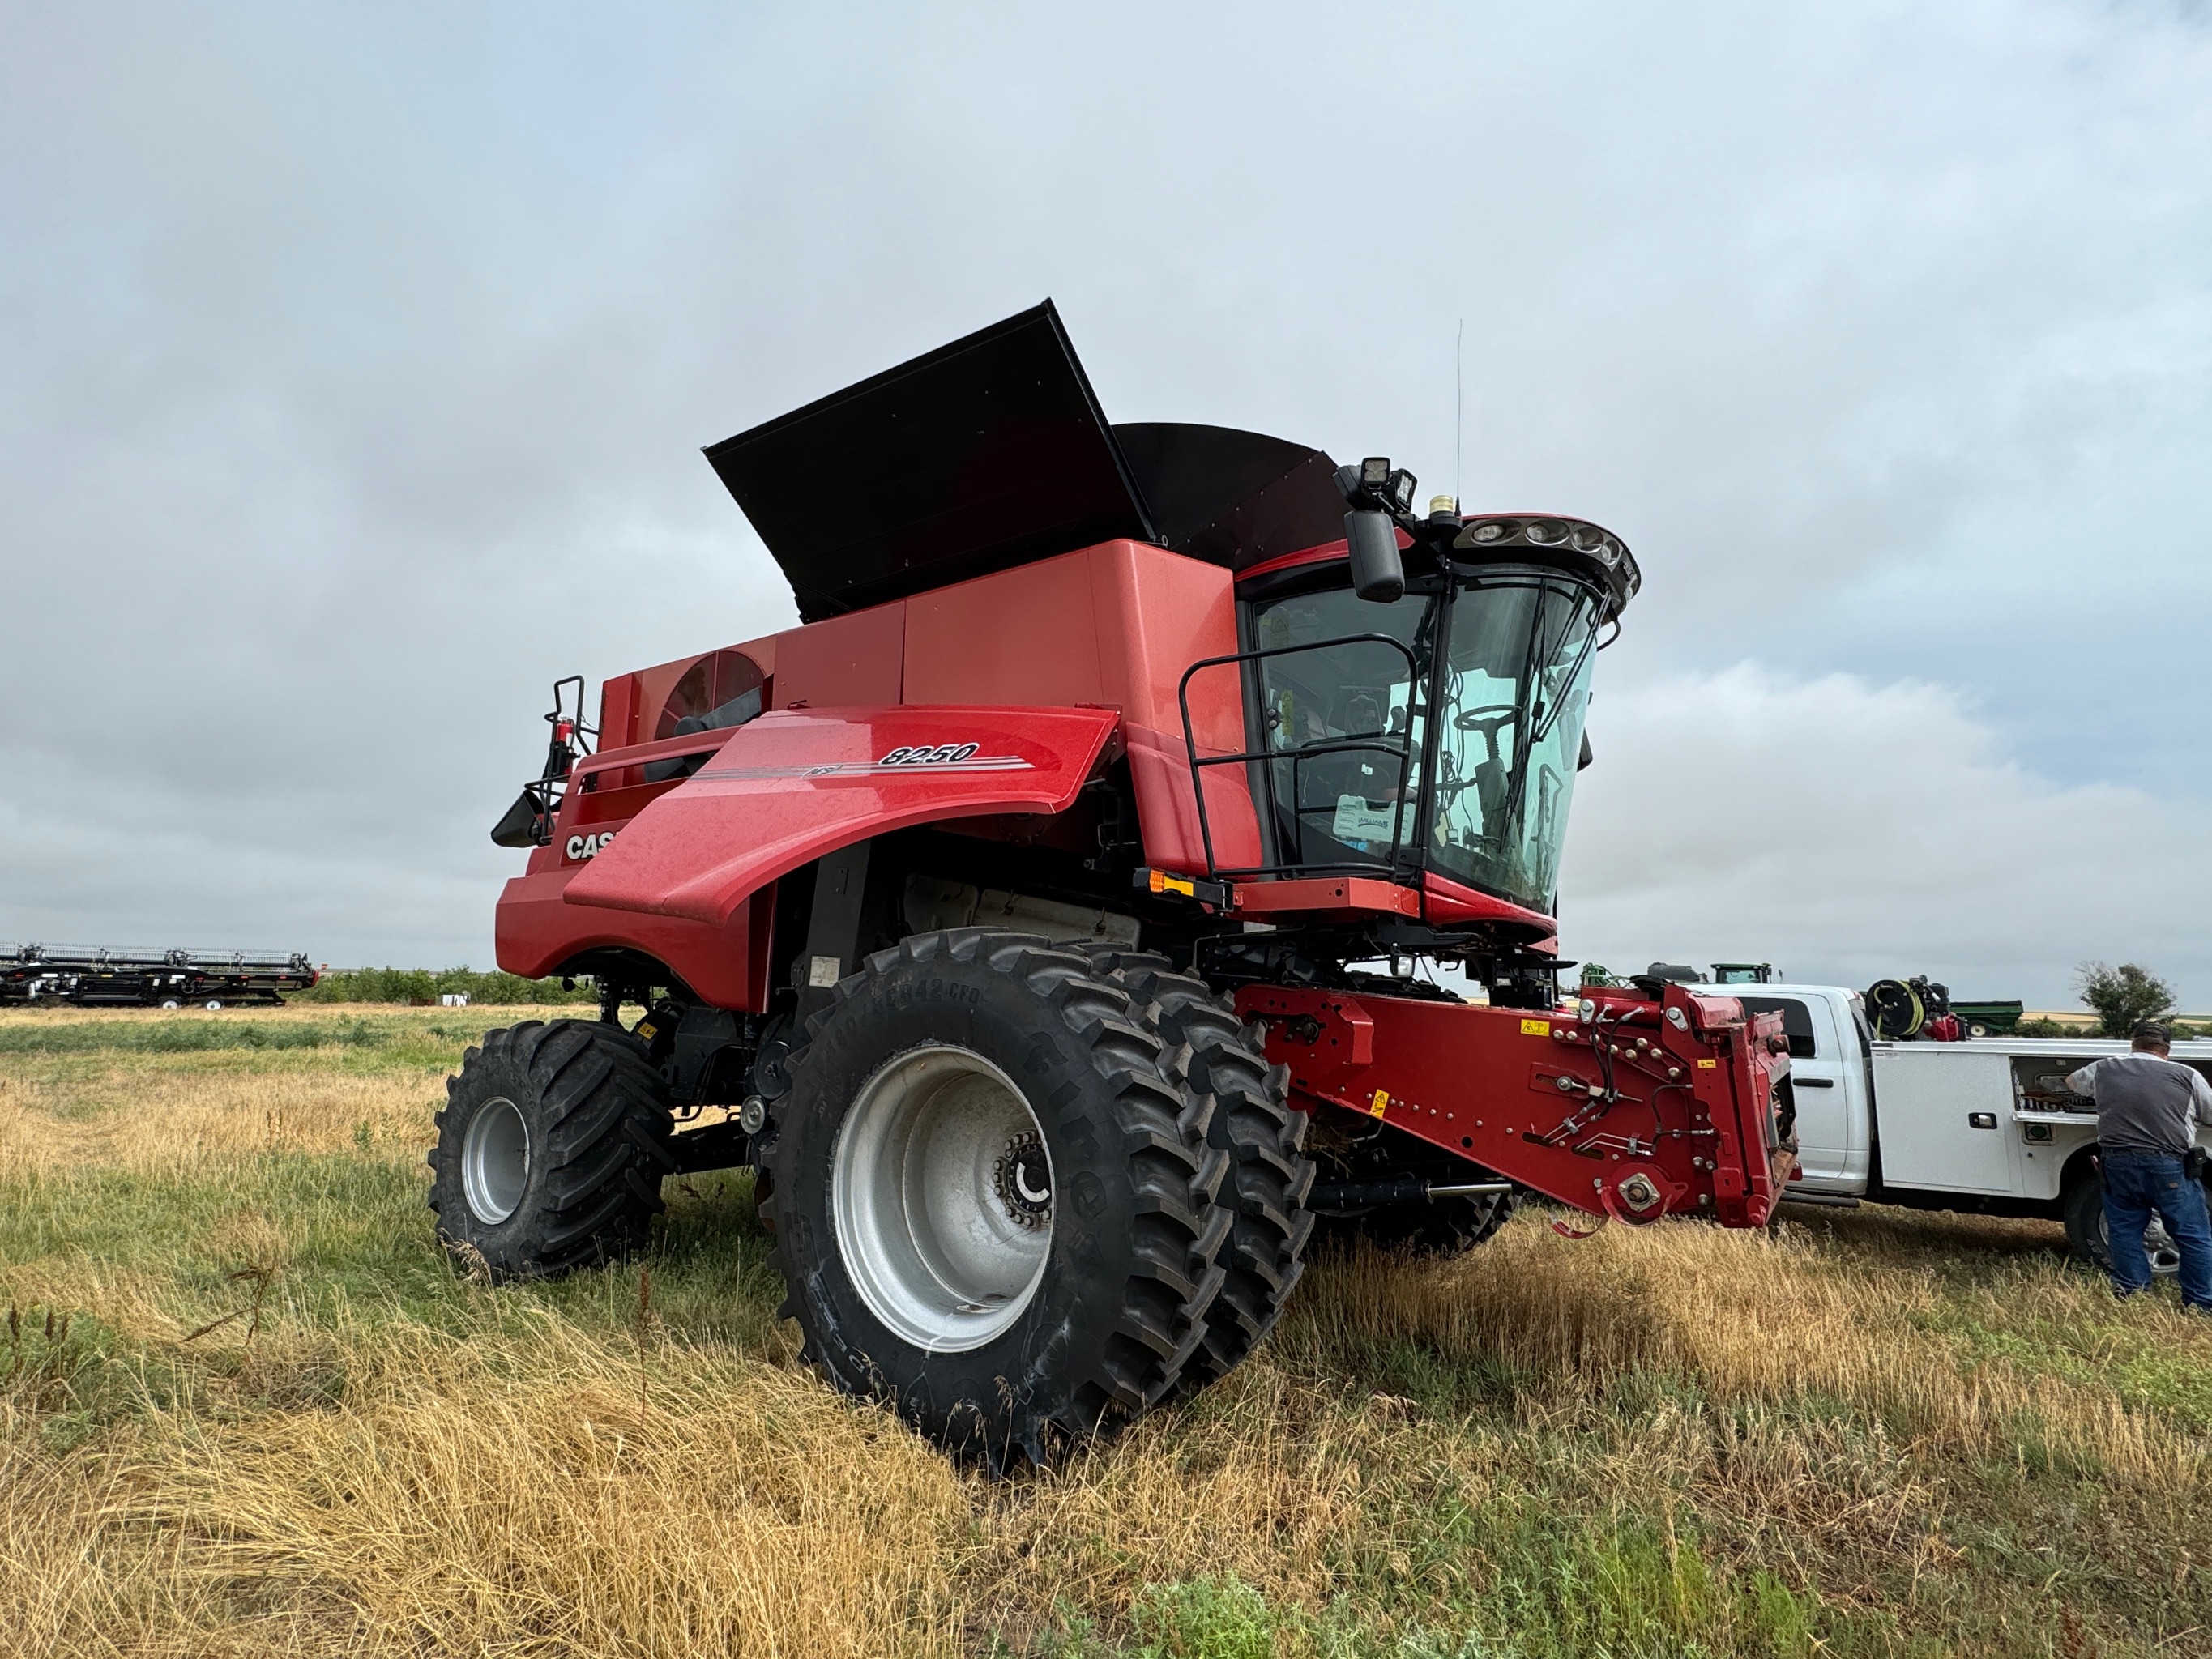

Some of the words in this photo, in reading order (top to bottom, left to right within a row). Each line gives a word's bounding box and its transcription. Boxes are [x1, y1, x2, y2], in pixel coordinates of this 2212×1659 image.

[878, 742, 980, 766] 8250
[1357, 817, 1390, 828] WILLIAMS
[566, 831, 621, 859] CAS
